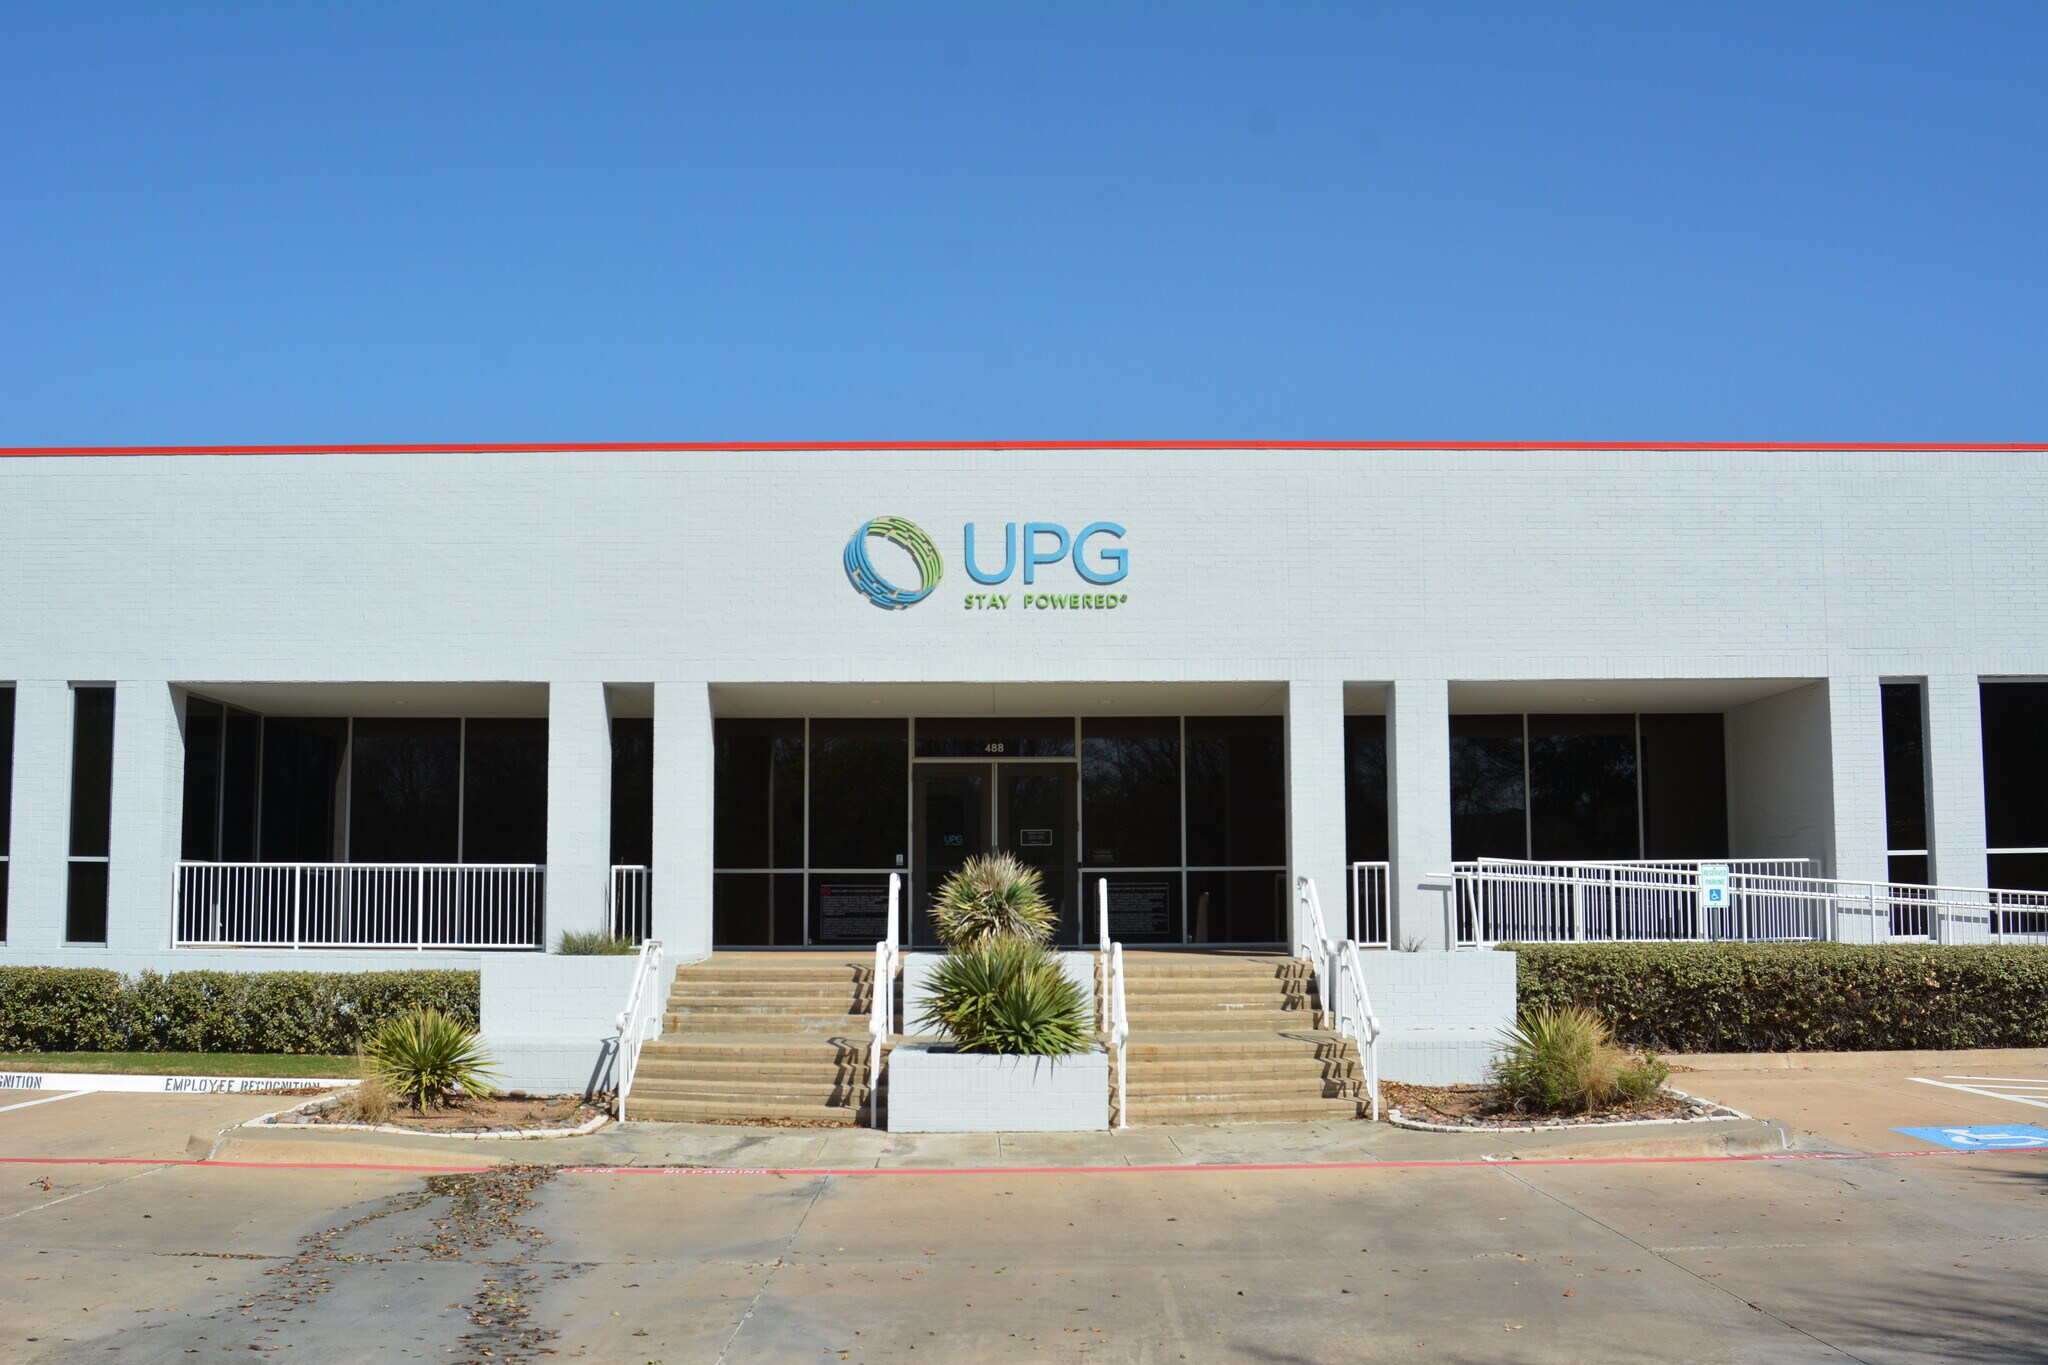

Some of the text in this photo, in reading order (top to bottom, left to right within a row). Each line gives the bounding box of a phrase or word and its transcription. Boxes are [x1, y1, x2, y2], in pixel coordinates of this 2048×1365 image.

[964, 521, 1129, 586] UPG
[964, 593, 1012, 610] STAY
[984, 743, 1004, 753] 488
[943, 835, 964, 843] UPG
[165, 1077, 235, 1092] EMPLOYEE
